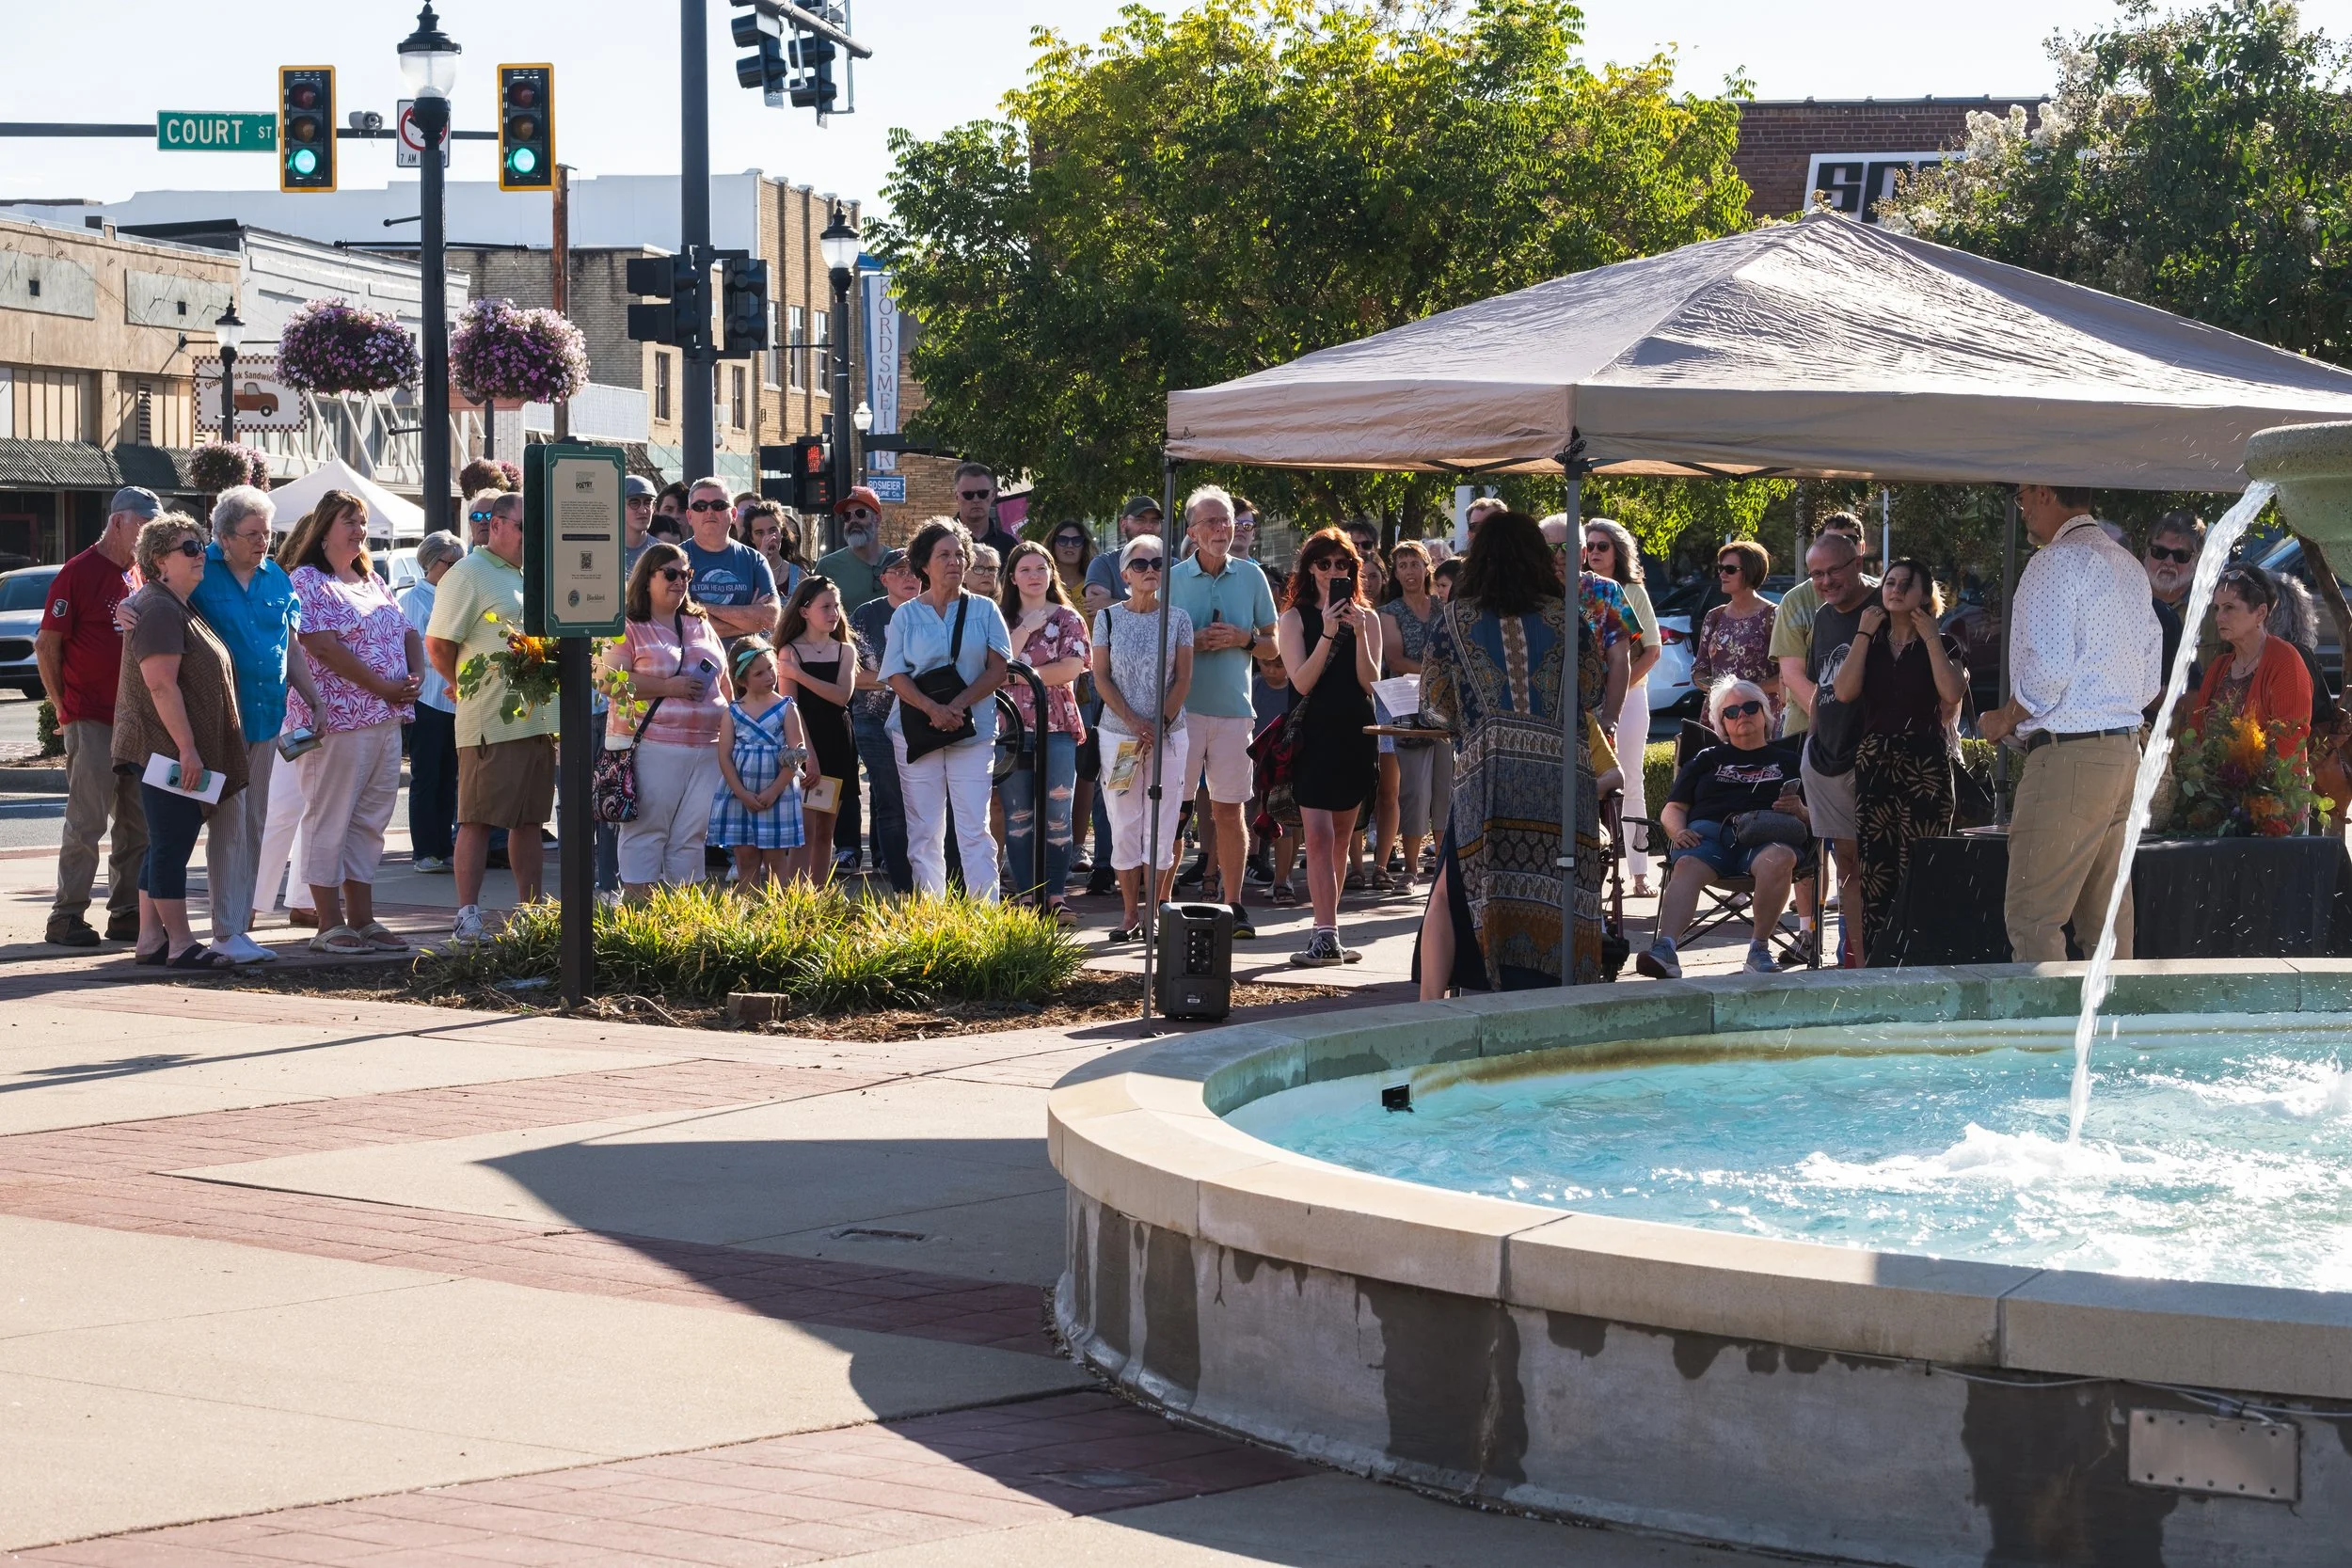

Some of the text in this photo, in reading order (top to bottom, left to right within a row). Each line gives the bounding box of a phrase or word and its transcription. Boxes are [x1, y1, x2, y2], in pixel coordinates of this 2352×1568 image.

[167, 119, 272, 144] COURT ST
[400, 153, 417, 164] 7 AM
[877, 278, 894, 467] KORDSMEIR
[868, 481, 901, 490] RDSMEIER
[710, 584, 725, 593] HEAD
